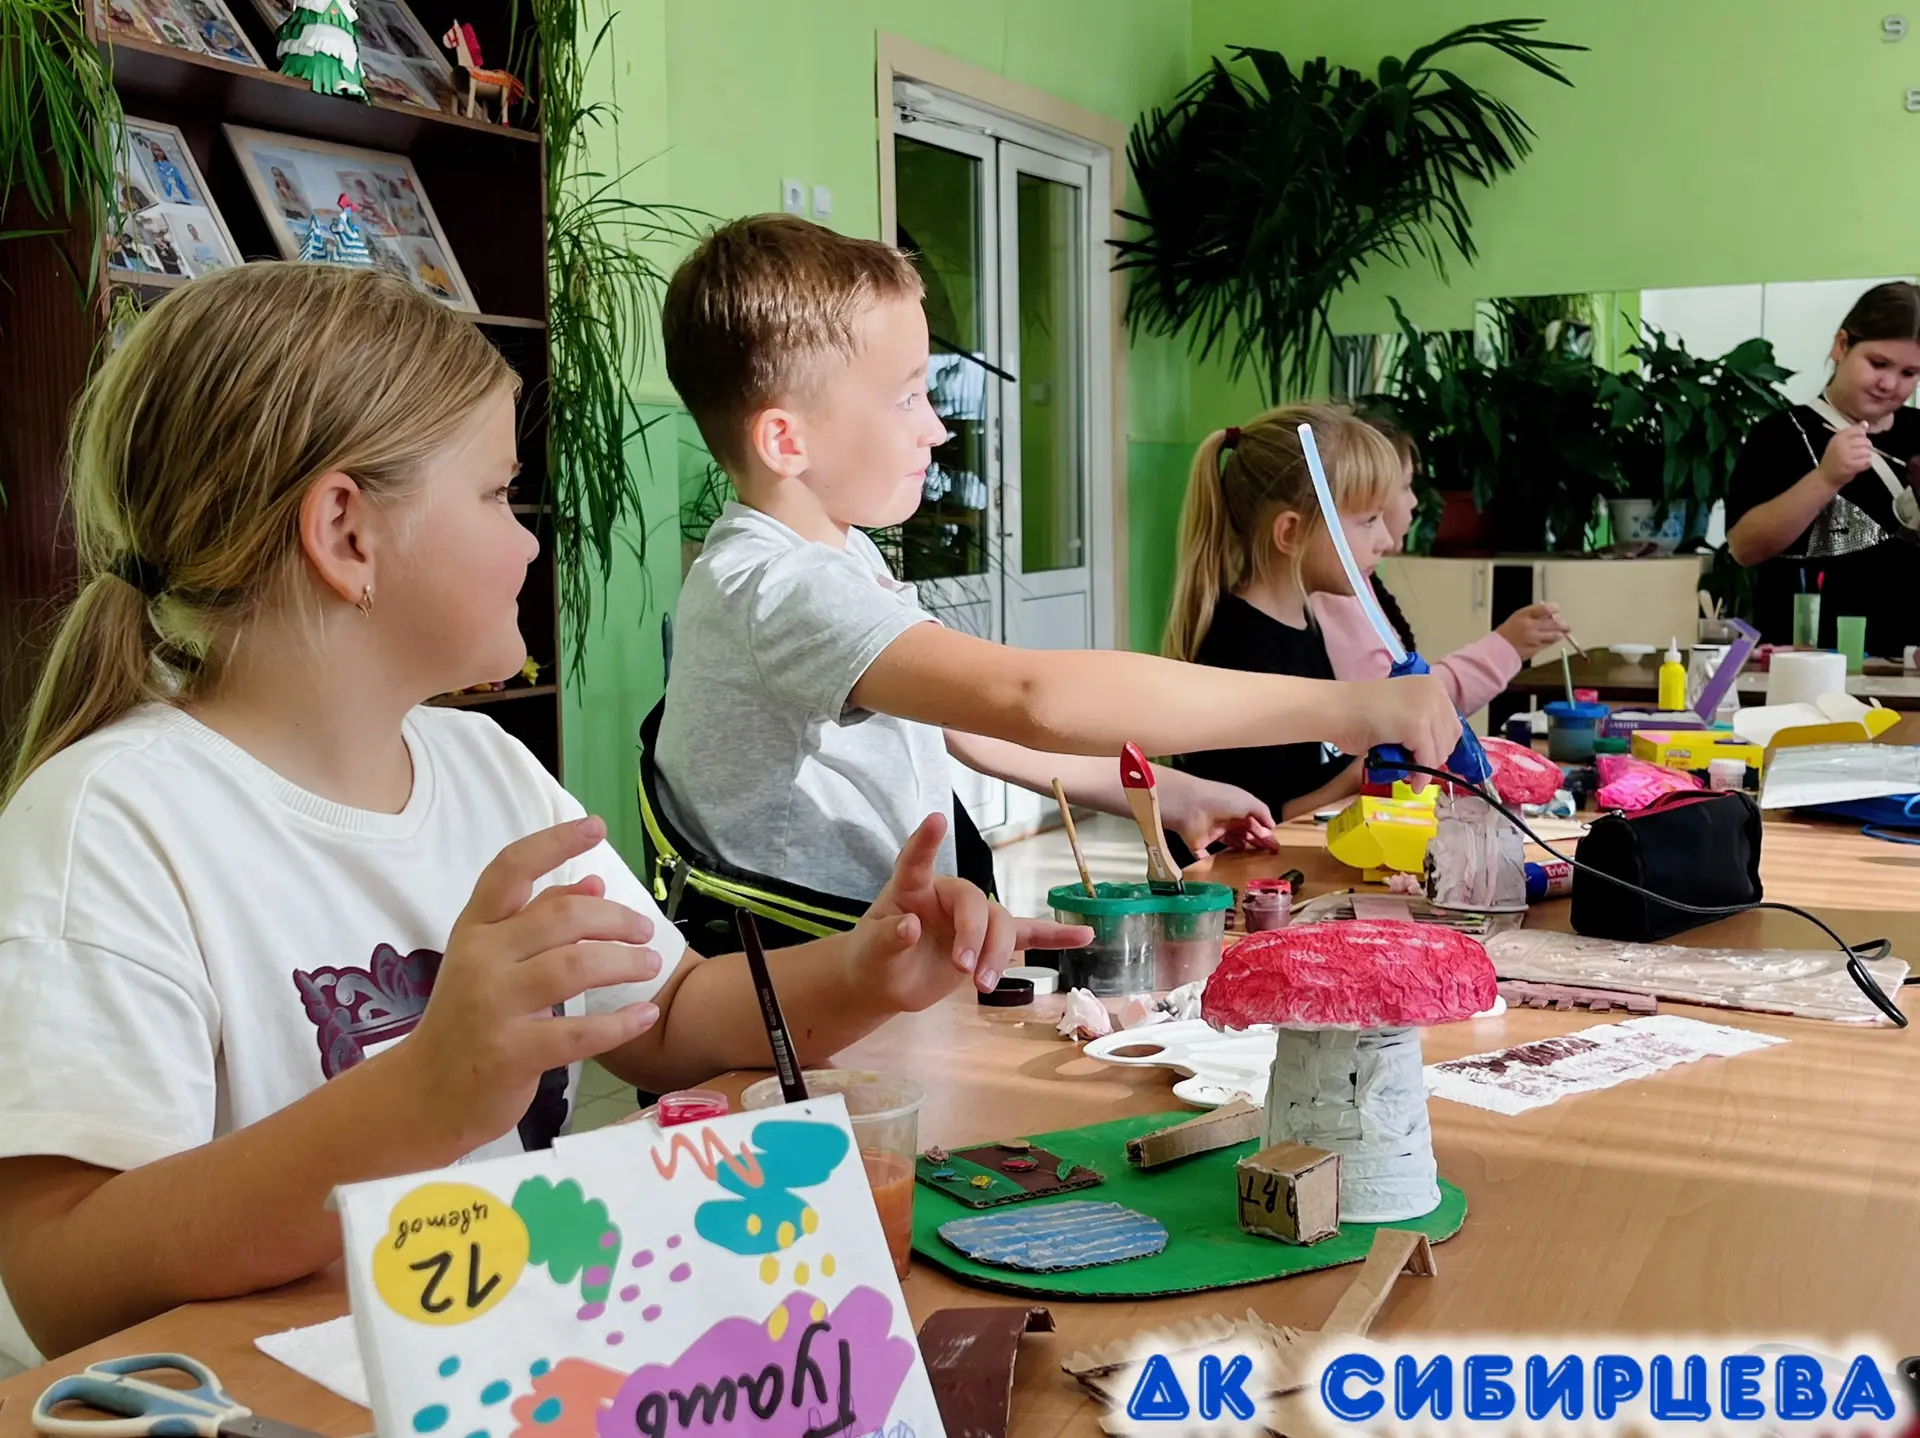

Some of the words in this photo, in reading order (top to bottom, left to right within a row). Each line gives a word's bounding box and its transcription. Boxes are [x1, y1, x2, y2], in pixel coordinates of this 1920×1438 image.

[394, 1201, 489, 1250] цветов
[409, 1241, 502, 1313] 12
[635, 1320, 857, 1438] Гуашь
